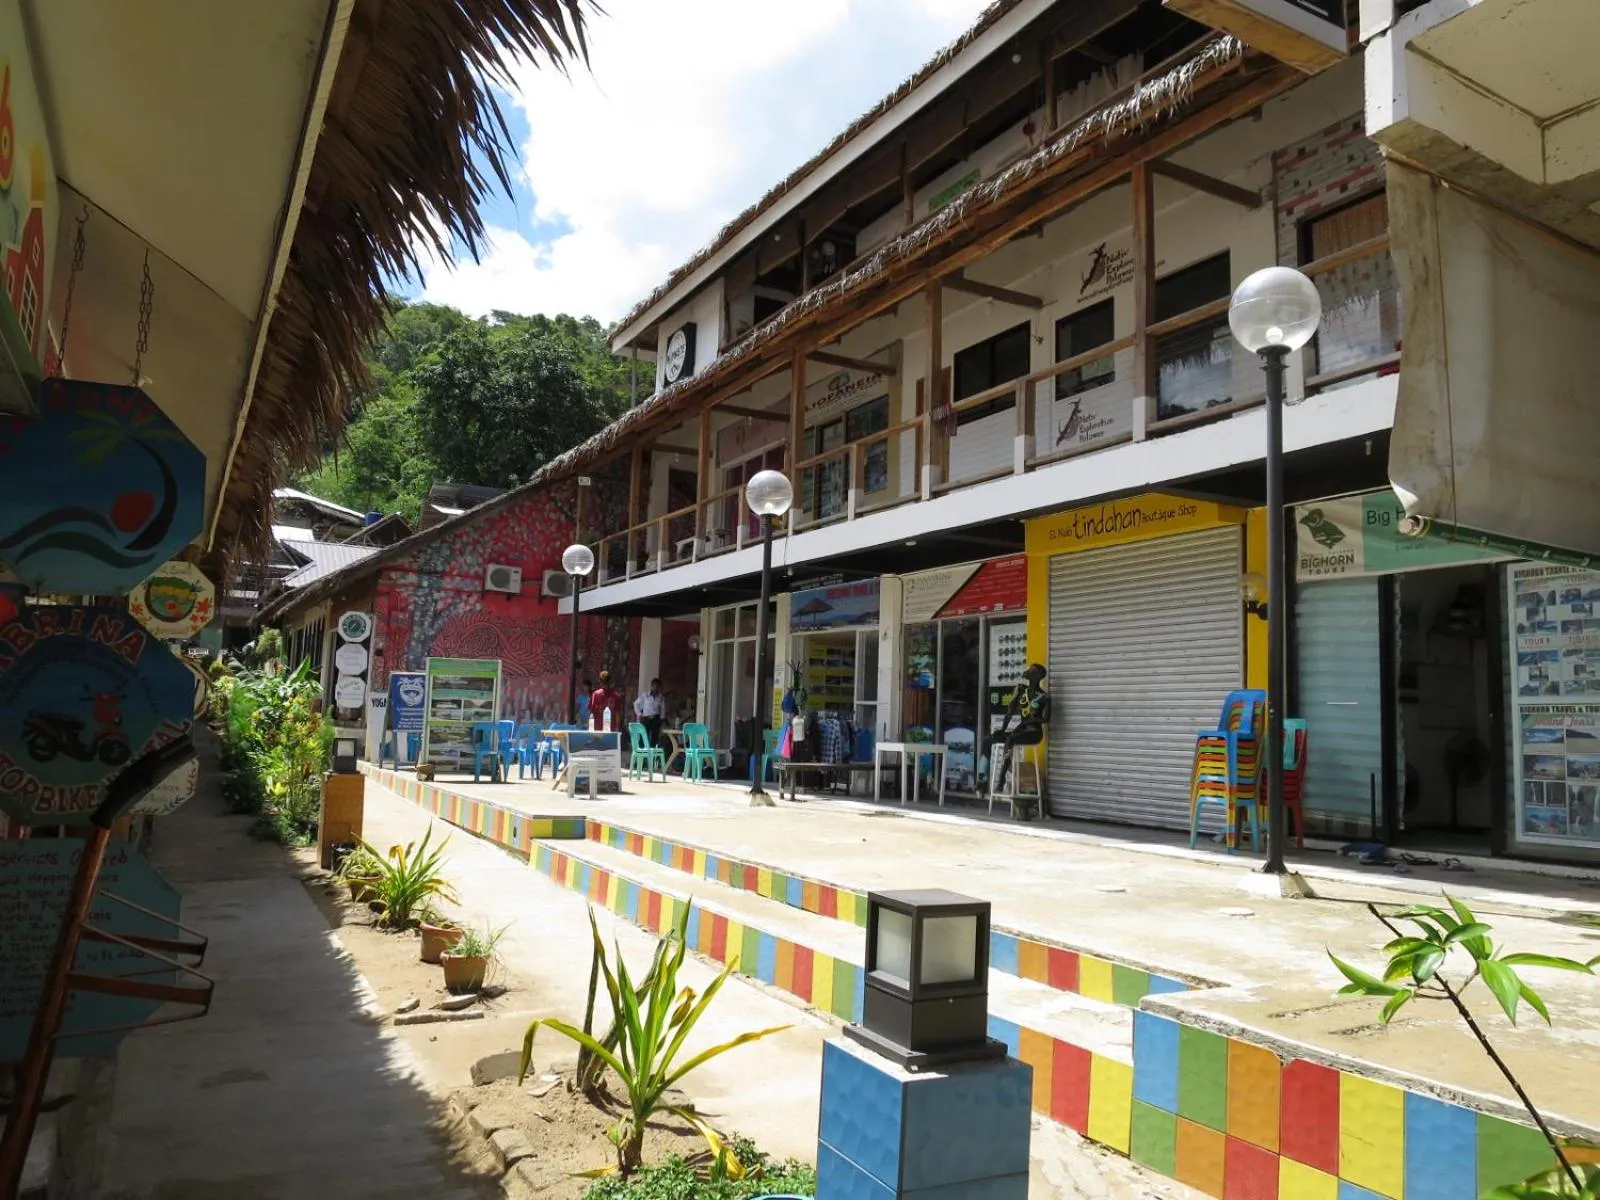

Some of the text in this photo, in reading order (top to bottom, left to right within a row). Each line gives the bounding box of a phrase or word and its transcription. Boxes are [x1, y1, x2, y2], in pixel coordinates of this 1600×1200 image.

[1178, 503, 1197, 518] Shop
[1366, 510, 1390, 527] Big
[1300, 554, 1355, 571] BIGHORN
[0, 608, 147, 671] BRINA
